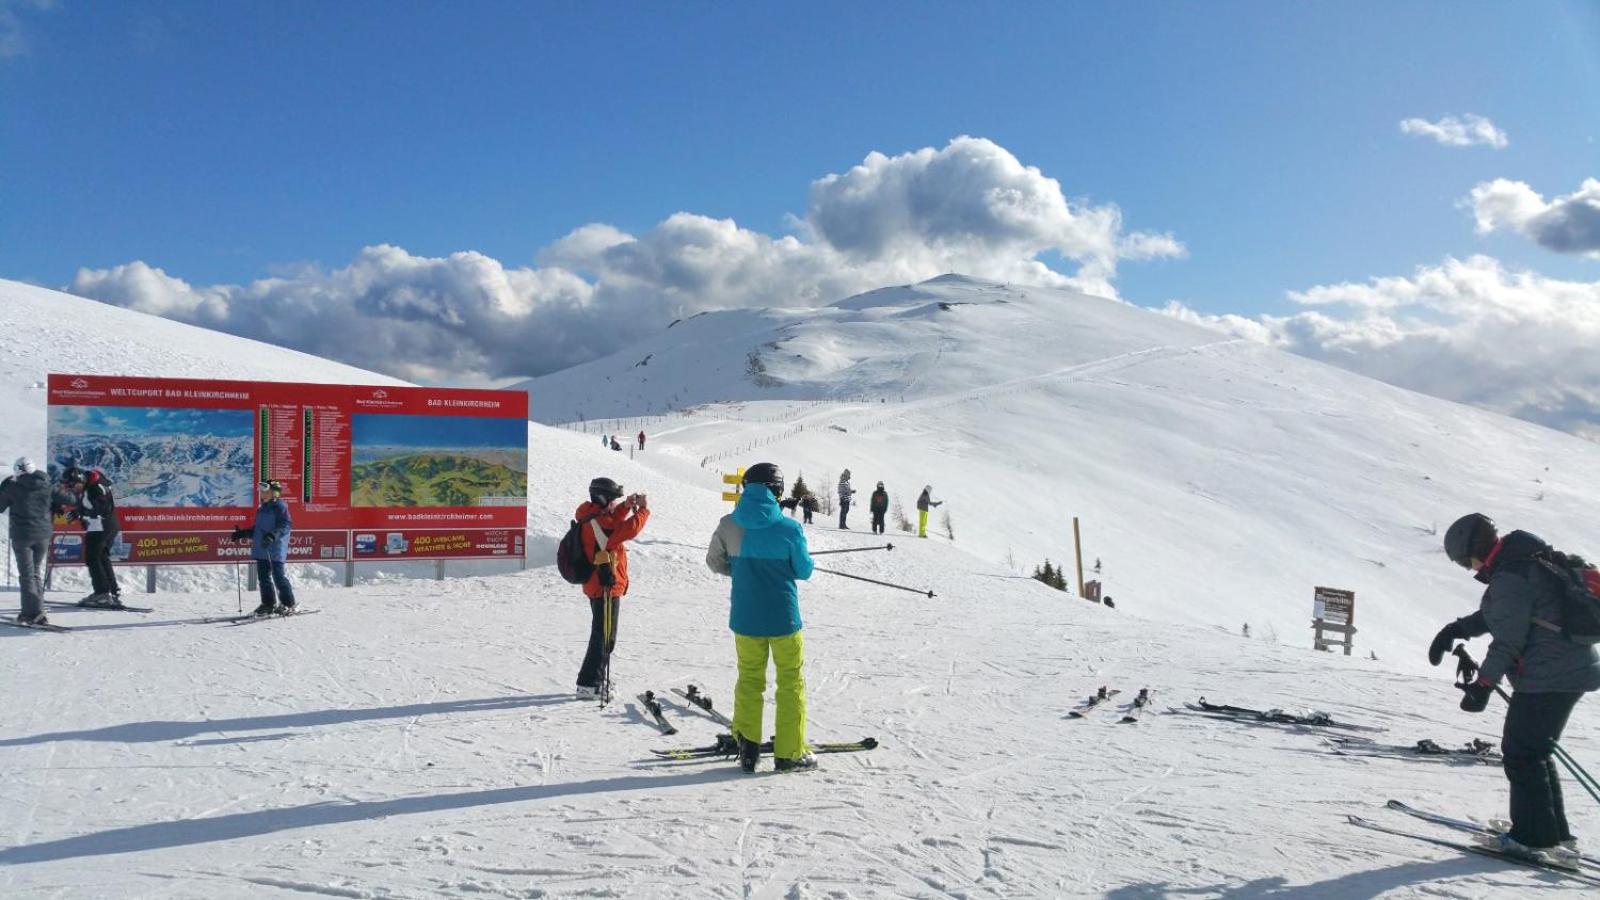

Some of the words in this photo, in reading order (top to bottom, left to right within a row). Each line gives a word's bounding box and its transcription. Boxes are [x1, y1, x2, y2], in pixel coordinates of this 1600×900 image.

[110, 388, 163, 397] WELTCUPORT
[165, 389, 182, 397] BAD
[184, 390, 249, 399] KLEINKIRCHHEIM
[444, 400, 500, 408] KLEINKIRCHHEIM
[124, 514, 246, 522] www.badkleinkirchheimer.com
[136, 537, 158, 548] 400
[160, 536, 201, 546] WEBCAMS
[414, 536, 431, 544] 400
[433, 535, 465, 543] WEBCAMS
[137, 547, 176, 557] WEATHER
[185, 544, 208, 553] MORE
